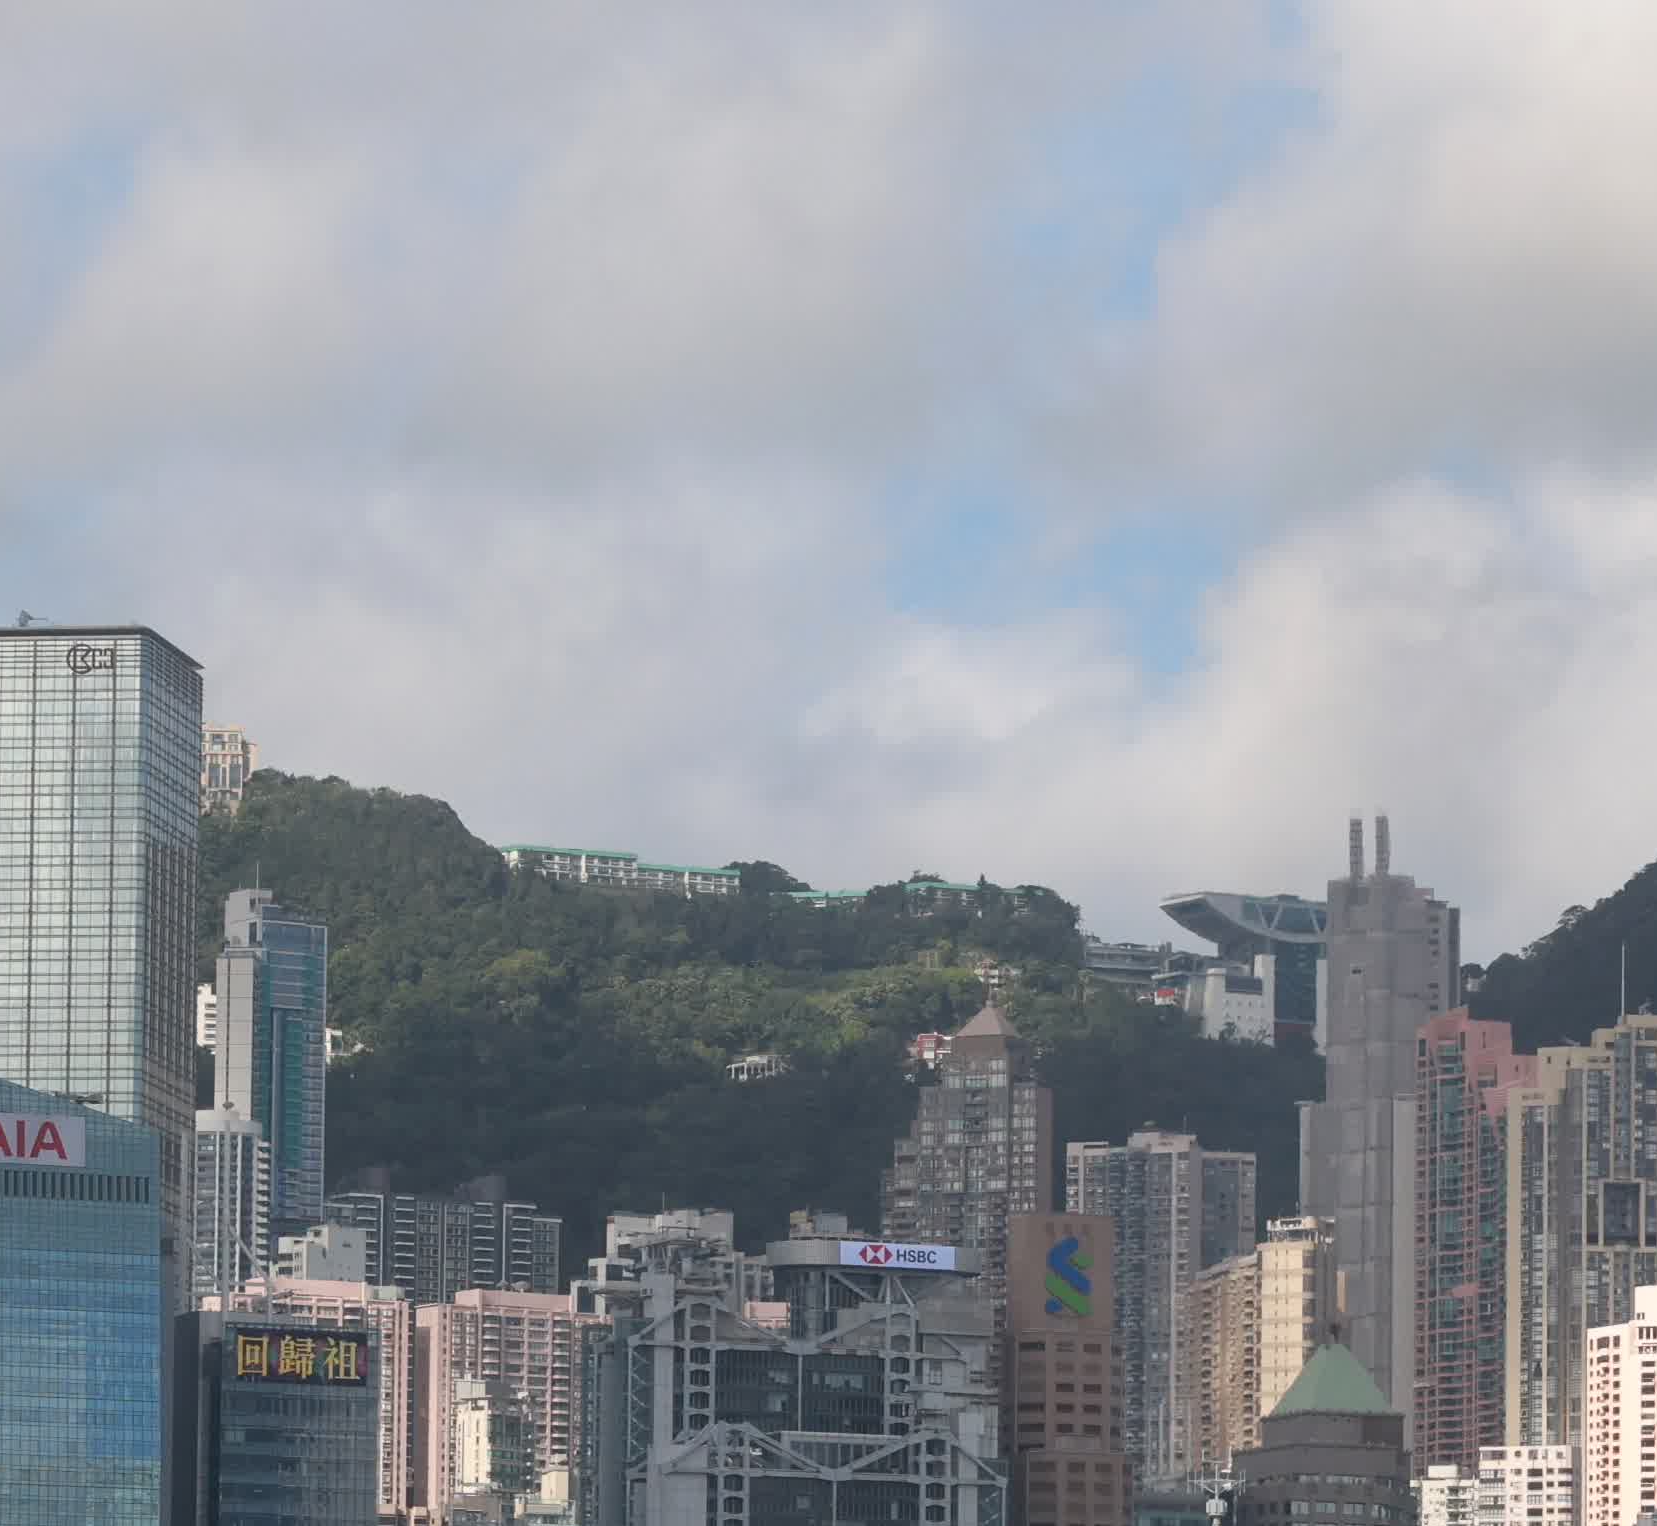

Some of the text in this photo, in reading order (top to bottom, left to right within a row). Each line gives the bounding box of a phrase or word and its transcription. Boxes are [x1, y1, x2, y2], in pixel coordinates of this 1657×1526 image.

[895, 1248, 938, 1264] HSBC
[237, 1334, 361, 1380] 回歸祖
